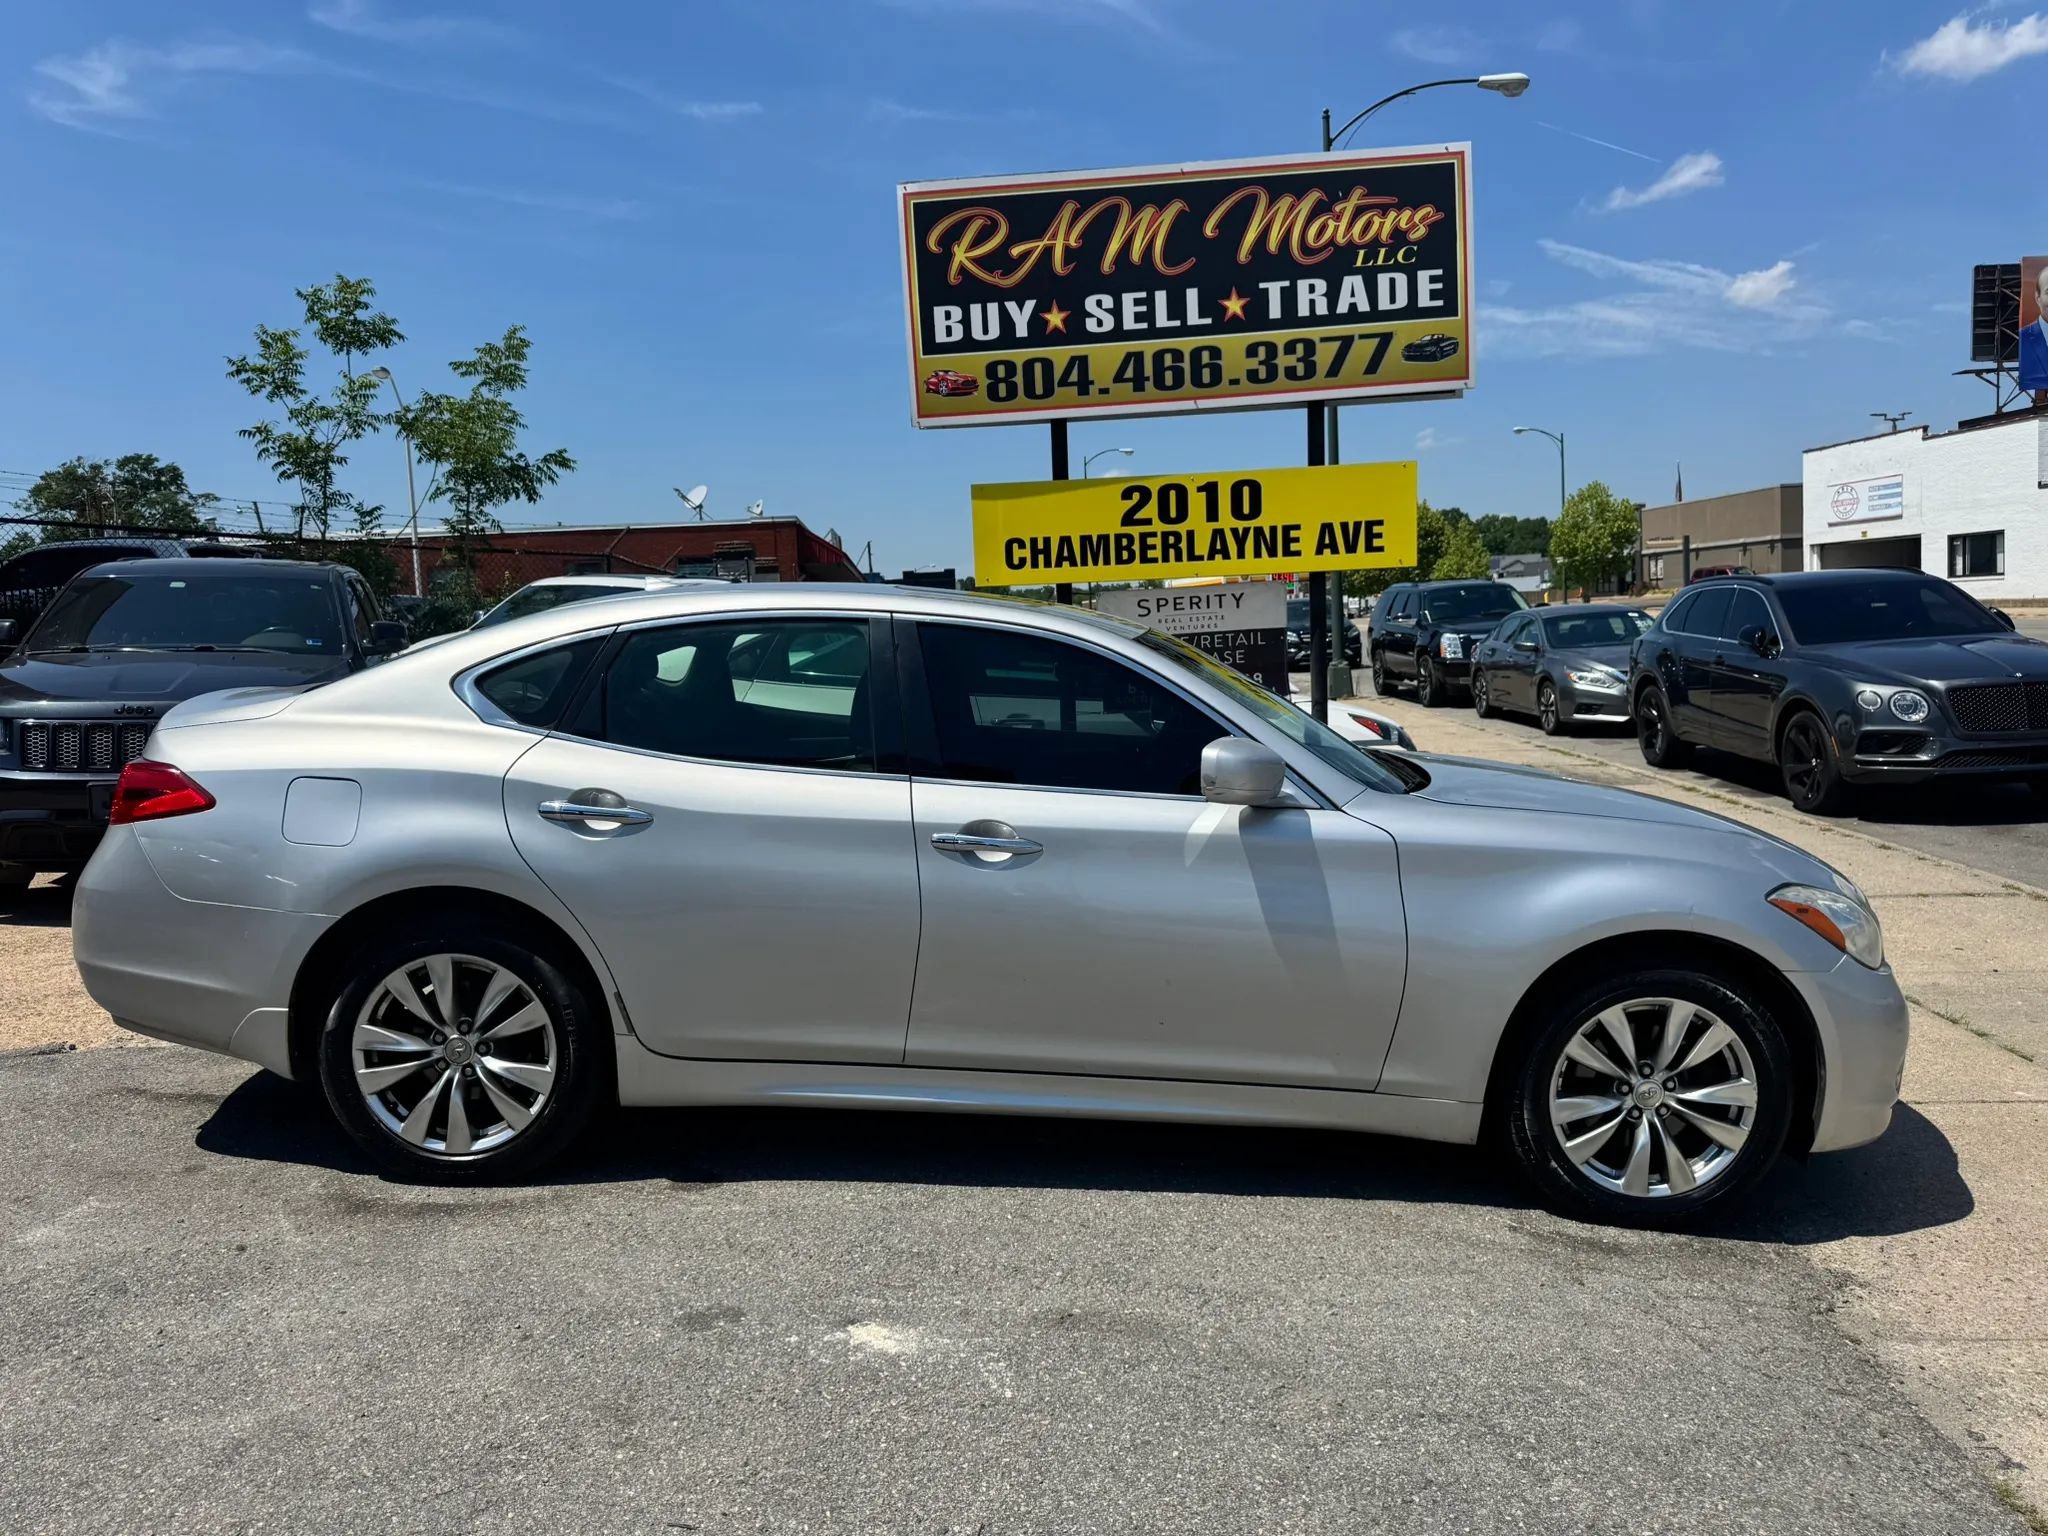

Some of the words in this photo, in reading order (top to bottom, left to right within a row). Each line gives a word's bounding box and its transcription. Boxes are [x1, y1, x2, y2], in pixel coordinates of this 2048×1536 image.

[926, 196, 1196, 288] RAM
[1203, 186, 1445, 265] Motors
[1353, 245, 1418, 268] LLC
[933, 300, 1037, 343] BUY
[1084, 287, 1213, 333] SELL
[1258, 268, 1444, 320] TRADE
[985, 331, 1396, 403] 804.466.3377
[1120, 478, 1262, 527] 2010
[1004, 523, 1302, 570] CHAMBERLAYNE
[1314, 519, 1385, 556] AVE
[1137, 592, 1245, 617] SPERITY
[1189, 615, 1225, 623] ESTATE
[1166, 623, 1219, 631] VENTURES
[114, 704, 154, 716] Jeep
